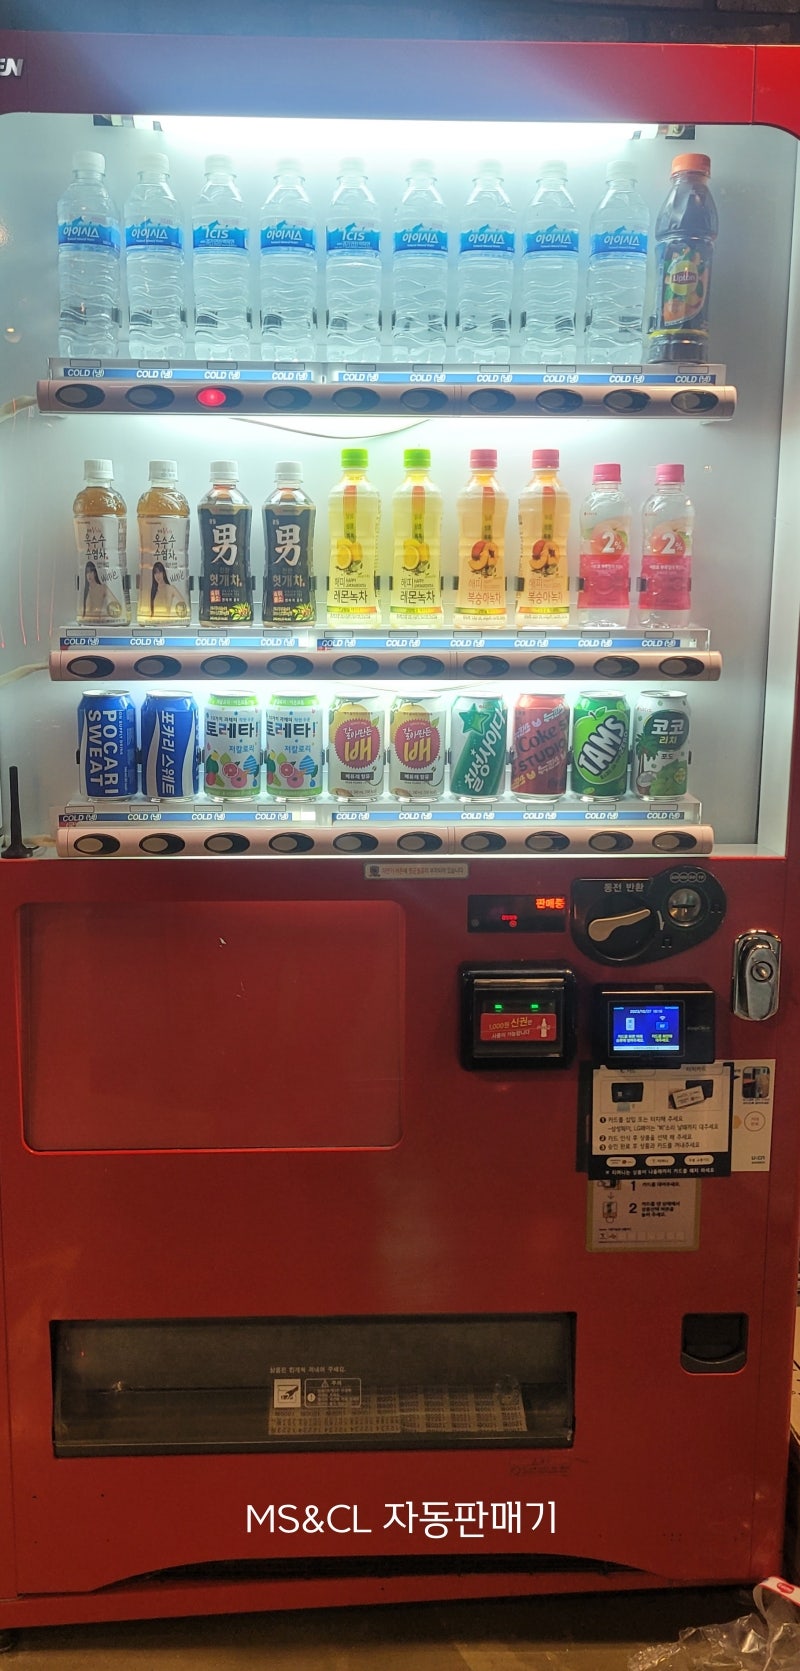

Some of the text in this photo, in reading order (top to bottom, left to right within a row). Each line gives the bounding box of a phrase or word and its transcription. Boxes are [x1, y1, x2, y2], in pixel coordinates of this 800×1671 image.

[64, 226, 100, 238] 아이시스
[132, 228, 168, 239] 아이시스
[267, 229, 302, 240] 아이시스
[402, 232, 438, 243] 아이시스
[468, 233, 505, 244] 아이시스
[536, 234, 572, 245] 아이시스
[604, 235, 640, 246] 아이시스
[673, 274, 696, 282] Lipton
[68, 368, 90, 377] COLD
[136, 370, 159, 378] COLD
[204, 371, 226, 379] COLD
[272, 372, 293, 380] COLD
[343, 373, 364, 381] COLD
[410, 374, 432, 382] COLD
[476, 374, 498, 382] COLD
[543, 374, 565, 382] COLD
[609, 374, 631, 383] COLD
[675, 375, 697, 383] COLD
[84, 533, 106, 549] 옥수수
[153, 534, 176, 549] 옥수수
[212, 523, 238, 566] 男
[274, 523, 300, 566] 男
[602, 531, 622, 553] 2%
[660, 532, 682, 554] 2%
[85, 550, 106, 561] 수염차
[153, 550, 175, 561] 수염차
[210, 574, 239, 588] 헛개차
[272, 574, 302, 588] 헛개차
[334, 589, 368, 604] 레몬녹차
[400, 590, 435, 604] 레몬녹차
[468, 592, 501, 605] 복숭아녹차
[528, 592, 562, 605] 복숭아녹차
[63, 638, 86, 646] COLD
[130, 638, 151, 646] COLD
[195, 638, 217, 646] COLD
[260, 638, 282, 646] COLD
[321, 639, 342, 647] COLD
[450, 640, 472, 648] COLD
[514, 640, 536, 648] COLD
[578, 639, 599, 647] COLD
[641, 639, 662, 647] COLD
[206, 722, 259, 738] 토레타!
[266, 722, 316, 738] 토레타!
[651, 719, 685, 735] 코코
[343, 727, 372, 740] 갈아만든
[403, 727, 432, 740] 갈아만든
[518, 726, 557, 752] Coke
[579, 716, 624, 775] TAMS
[659, 736, 676, 744] 리치
[88, 710, 103, 786] SWEAT
[103, 710, 118, 794] POCARI
[162, 710, 175, 795] 포카리 스웨트
[229, 745, 254, 753] 저칼로리
[284, 745, 311, 753] 저칼로리
[345, 736, 372, 762] 배
[404, 737, 430, 762] 배
[464, 707, 506, 792] 칠성사이다
[519, 738, 565, 772] STUDIO
[191, 813, 212, 821] COLD
[255, 813, 276, 821] COLD
[336, 813, 357, 821] COLD
[398, 812, 420, 820] COLD
[461, 812, 482, 820] COLD
[523, 812, 544, 820] COLD
[585, 812, 606, 820] COLD
[647, 812, 668, 820] COLD
[604, 883, 644, 892] 동전 반환
[536, 897, 565, 909] 판매중
[631, 1181, 636, 1191] 1
[629, 1203, 637, 1214] 2
